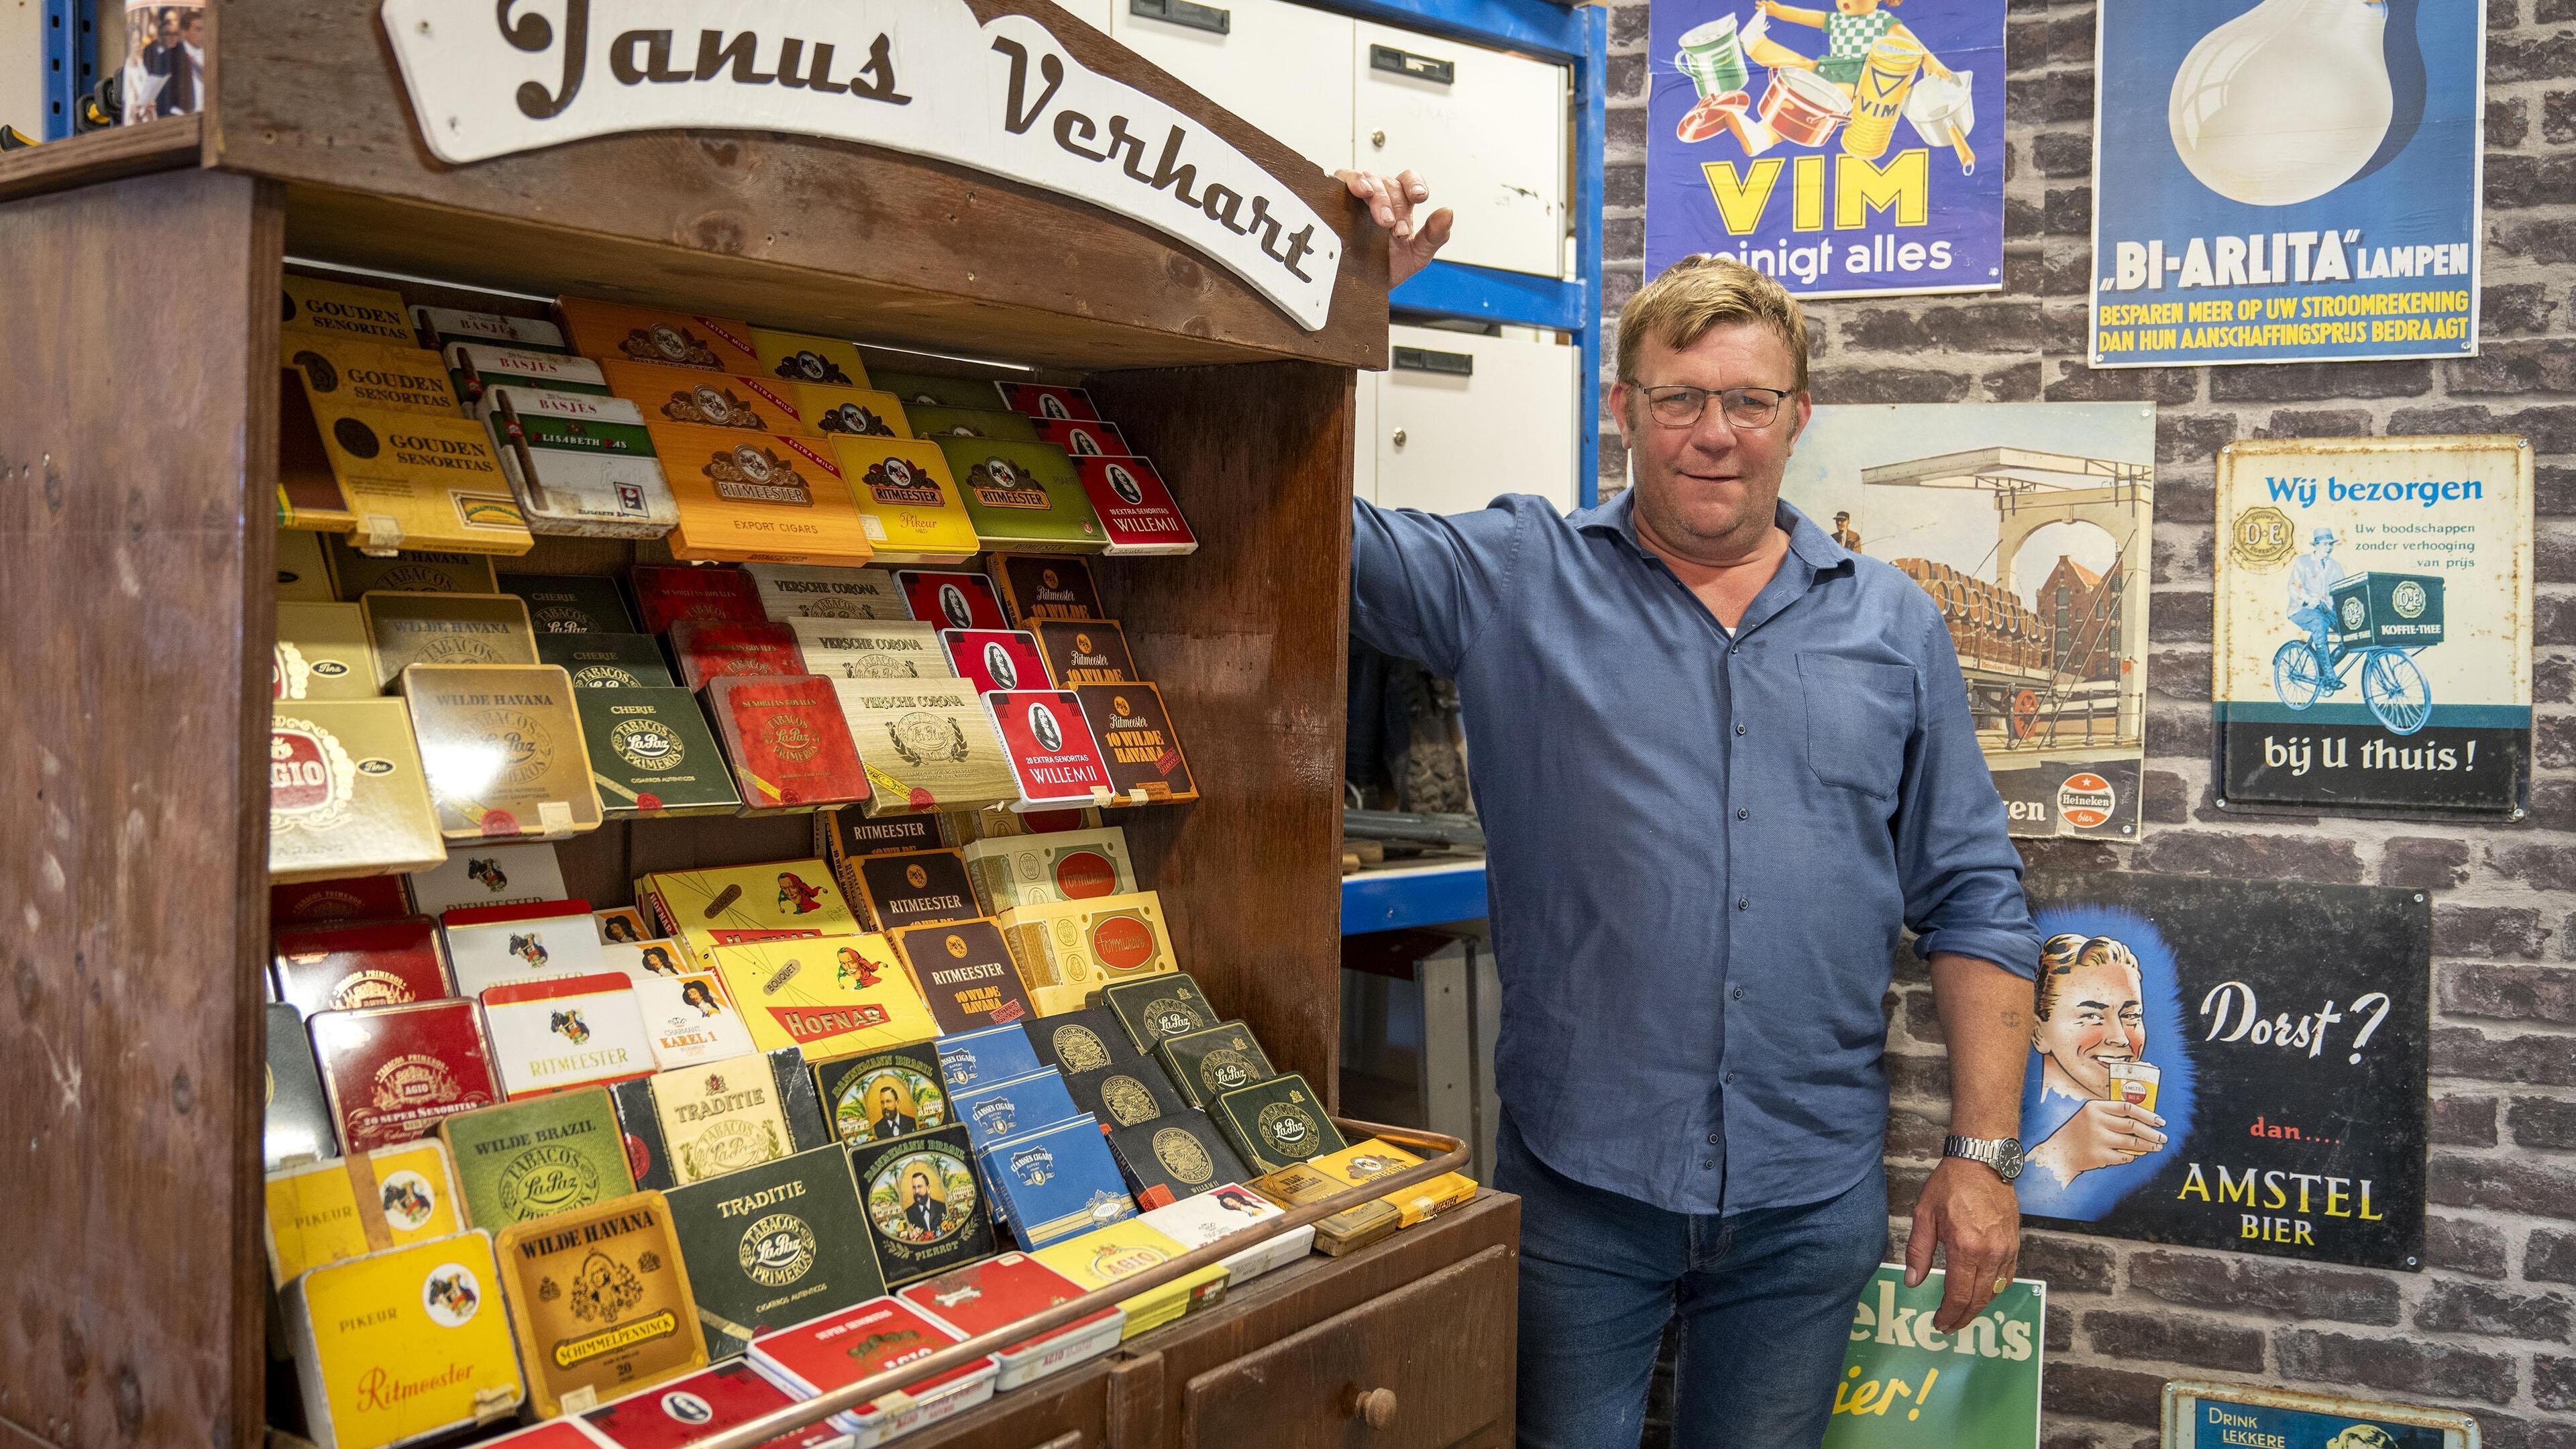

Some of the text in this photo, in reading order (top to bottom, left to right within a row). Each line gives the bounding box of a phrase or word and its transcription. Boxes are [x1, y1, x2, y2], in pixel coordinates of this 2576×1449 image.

[1861, 96, 1898, 117] VIM
[497, 0, 1313, 284] Janus Verhart
[1701, 148, 1929, 235] VIM
[1846, 234, 1952, 273] alles
[2357, 244, 2469, 279] LAMPEN
[306, 299, 402, 325] GOUDEN
[2100, 290, 2469, 327] BESPAREN MEER OP UW STROOMREKENING
[313, 316, 408, 340] SENORITAS
[705, 320, 750, 353] EXTRA MILD
[2099, 329, 2133, 352] DAN
[2140, 329, 2176, 351] HUN
[2372, 317, 2469, 342] BEDRAAGT
[499, 358, 558, 374] BASJES
[347, 368, 445, 392] GOUDEN
[354, 386, 451, 409] SENORITAS
[539, 400, 597, 414] BASJES
[748, 380, 794, 414] EXTRA MILD
[390, 433, 486, 458] GOUDEN
[788, 439, 835, 472] EXTRA MILD
[397, 452, 494, 473] SENORITAS
[720, 481, 806, 502] RITMEESTER
[875, 488, 938, 502] RITMEESTER
[981, 490, 1044, 506] RITMEESTER
[2265, 476, 2483, 508] Wij bezorgen
[734, 520, 818, 535] EXPORT CIGARS
[900, 511, 937, 529] Pikeur
[1113, 518, 1166, 532] WILLEM
[2355, 523, 2475, 534] Uw boodschappen
[2355, 541, 2475, 553] zonder verhooging
[2417, 557, 2475, 570] van prijs
[773, 580, 880, 596] VERSCHE CORONA
[1037, 586, 1075, 602] Ritmeester
[813, 598, 857, 614] TABACOS
[1031, 604, 1089, 619] 10 WILDE
[818, 637, 923, 651] VERSCHE CORONA
[859, 655, 900, 670] TABACOS
[1071, 651, 1109, 666] Ritmeester
[579, 666, 630, 683] TABACOS
[1066, 669, 1124, 682] 10 WILDE
[436, 695, 553, 705] WILDE HAVANA
[859, 696, 965, 708] VERSCHE CORONA
[616, 720, 668, 736] TABACOS
[767, 714, 808, 729] TABACOS
[1110, 713, 1148, 729] Ritmeester
[1105, 730, 1165, 747] 10 WILDE
[625, 751, 682, 770] PRIMEROS
[1054, 754, 1089, 763] SENORITAS
[1114, 746, 1165, 763] HAVANA
[2265, 736, 2312, 776] bij
[2322, 737, 2348, 769] U
[1030, 766, 1098, 784] WILLEM II
[2063, 794, 2110, 807] Heineken
[2077, 811, 2094, 822] bier
[854, 822, 925, 840] RITMEESTER
[708, 888, 737, 916] BOUQUET
[889, 895, 961, 914] RITMEESTER
[766, 962, 796, 992] BOUQUET
[932, 963, 1005, 985] RITMEESTER
[955, 985, 1002, 1003] 10 WILDE
[961, 997, 1002, 1014] HAVANA
[1146, 999, 1187, 1018] TABACOS
[785, 1006, 885, 1036] HOFNAR
[529, 1046, 629, 1077] RITMEESTER
[956, 1053, 977, 1063] CIGARS
[1203, 1050, 1242, 1072] TABACOS
[832, 1055, 934, 1099] DANNEMANN BRASIL
[405, 1083, 429, 1095] AGIO
[674, 1087, 765, 1123] TRADITIE
[1260, 1104, 1301, 1124] TABACOS
[474, 1120, 596, 1155] WILDE BRAZIL
[701, 1120, 754, 1146] TABACOS
[1276, 1134, 1318, 1157] PRIMEROS
[508, 1147, 581, 1180] TABACOS
[864, 1139, 966, 1183] DANNEMANN BRASIL
[717, 1179, 806, 1219] TRADITIE
[2177, 1163, 2383, 1221] AMSTEL
[294, 1205, 353, 1229] PIKEUR
[520, 1210, 655, 1260] WILDE HAVANA
[746, 1215, 800, 1244] TABACOS
[2241, 1213, 2314, 1246] BIER
[915, 1241, 959, 1261] PIERROT
[751, 1250, 812, 1285] PRIMEROS
[1107, 1252, 1157, 1275] AGIO
[339, 1307, 398, 1333] PIKEUR
[559, 1318, 672, 1361] SCHIMMELPENNINCK
[356, 1363, 474, 1413] Ritmeester
[2208, 1407, 2257, 1430] DRINK
[2222, 1429, 2286, 1448] LEKKERE
